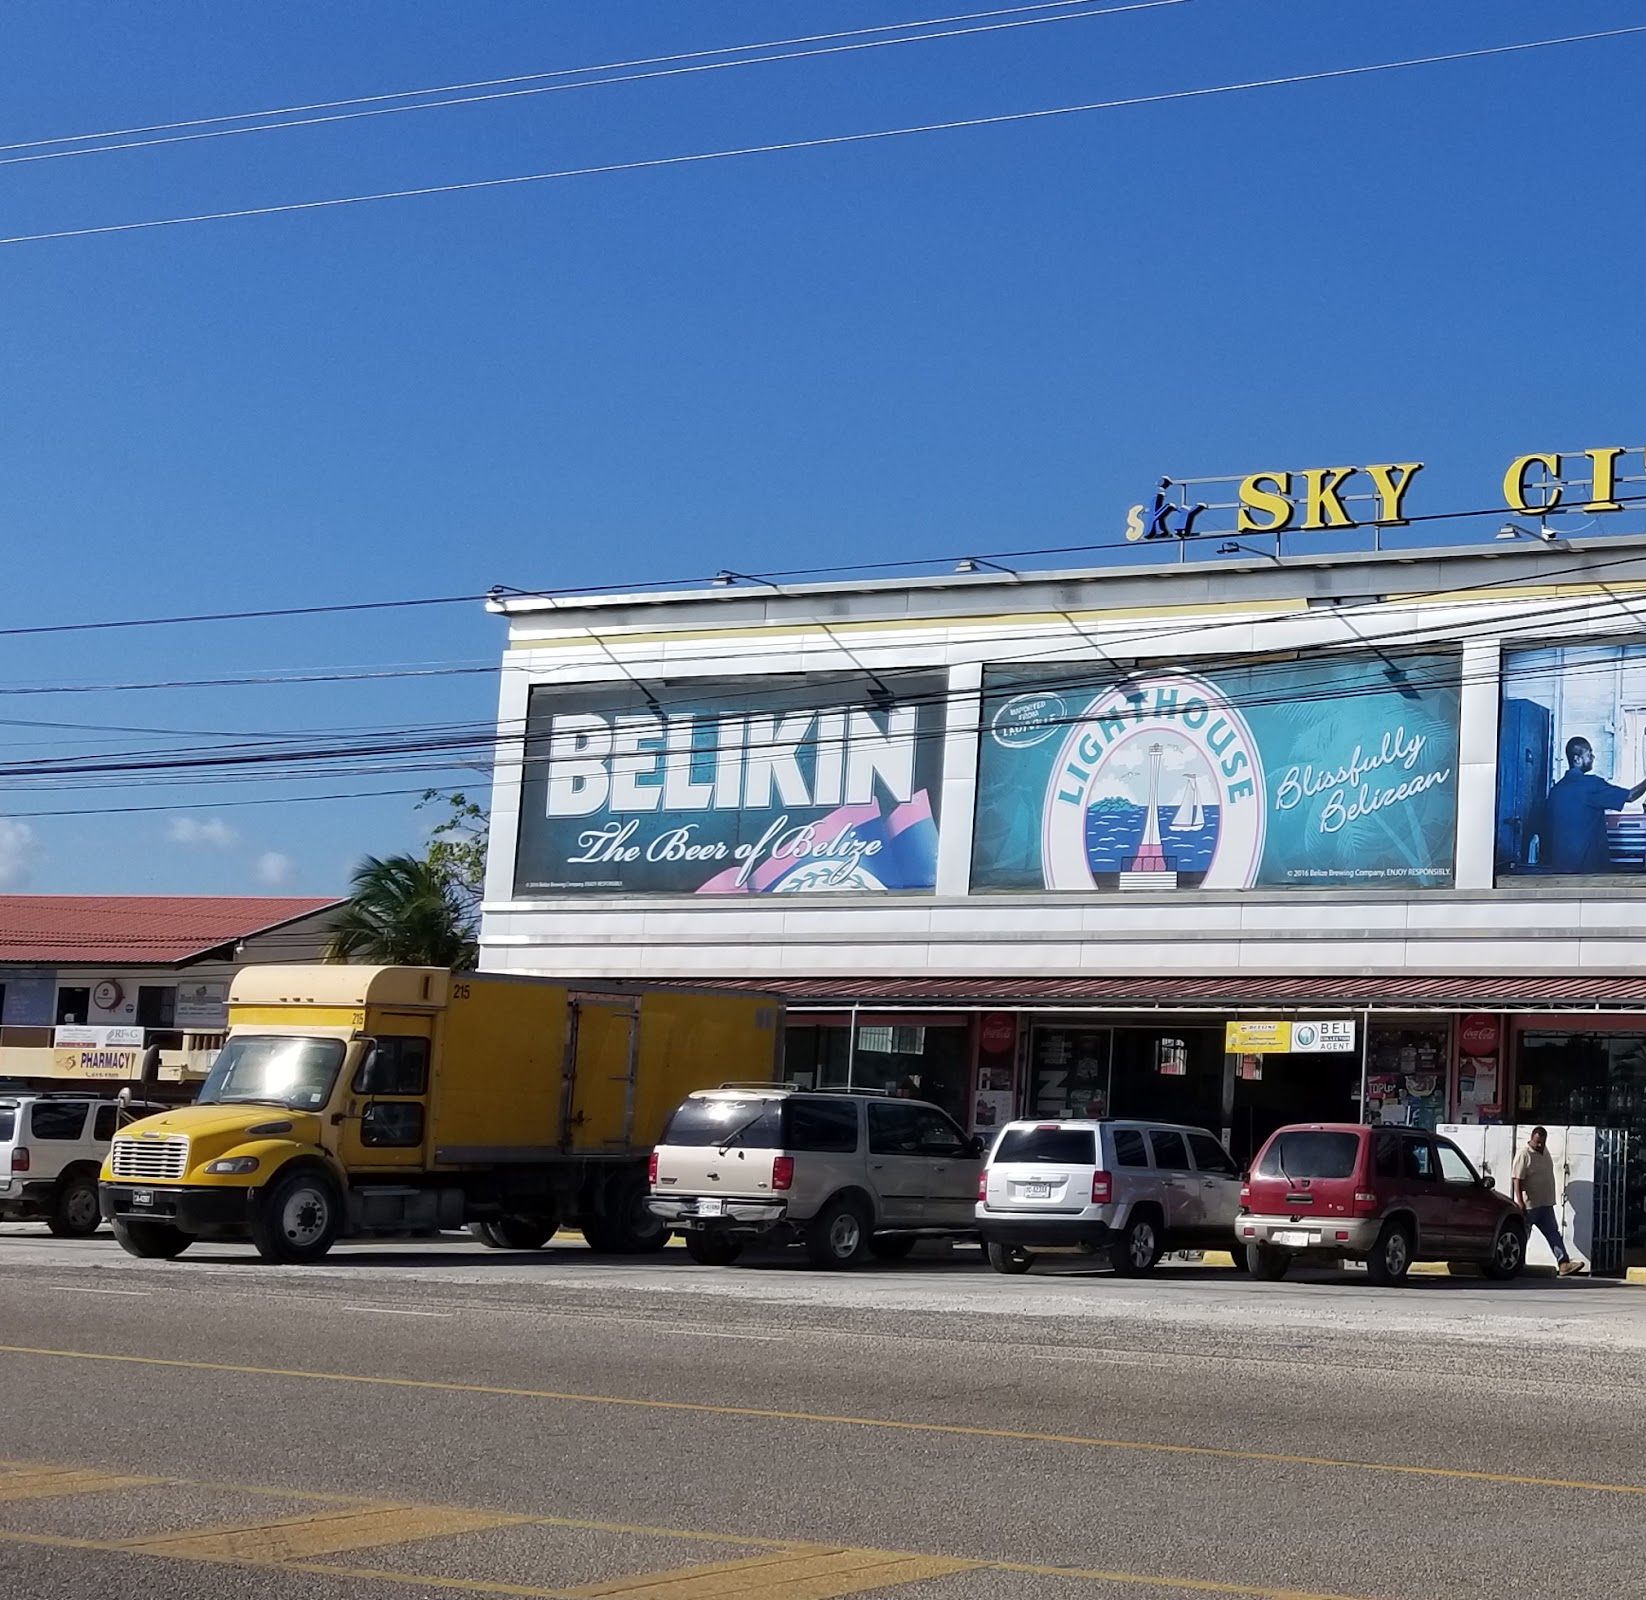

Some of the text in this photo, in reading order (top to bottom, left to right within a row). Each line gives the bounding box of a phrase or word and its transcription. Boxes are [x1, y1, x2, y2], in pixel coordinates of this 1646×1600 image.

[1237, 462, 1424, 533] SKY
[546, 704, 922, 818] BELIKIN
[1058, 688, 1254, 807] LIGHTHOUSE
[1276, 726, 1426, 810] Blissfully
[1320, 768, 1450, 833] Belizean
[567, 814, 883, 888] The Beer of Belize
[1328, 869, 1354, 878] Brewing
[1387, 868, 1407, 876] ENJOY
[352, 1013, 364, 1025] 215
[453, 984, 470, 999] 215
[81, 1052, 131, 1069] PHARMACY
[1321, 1023, 1351, 1034] BEL
